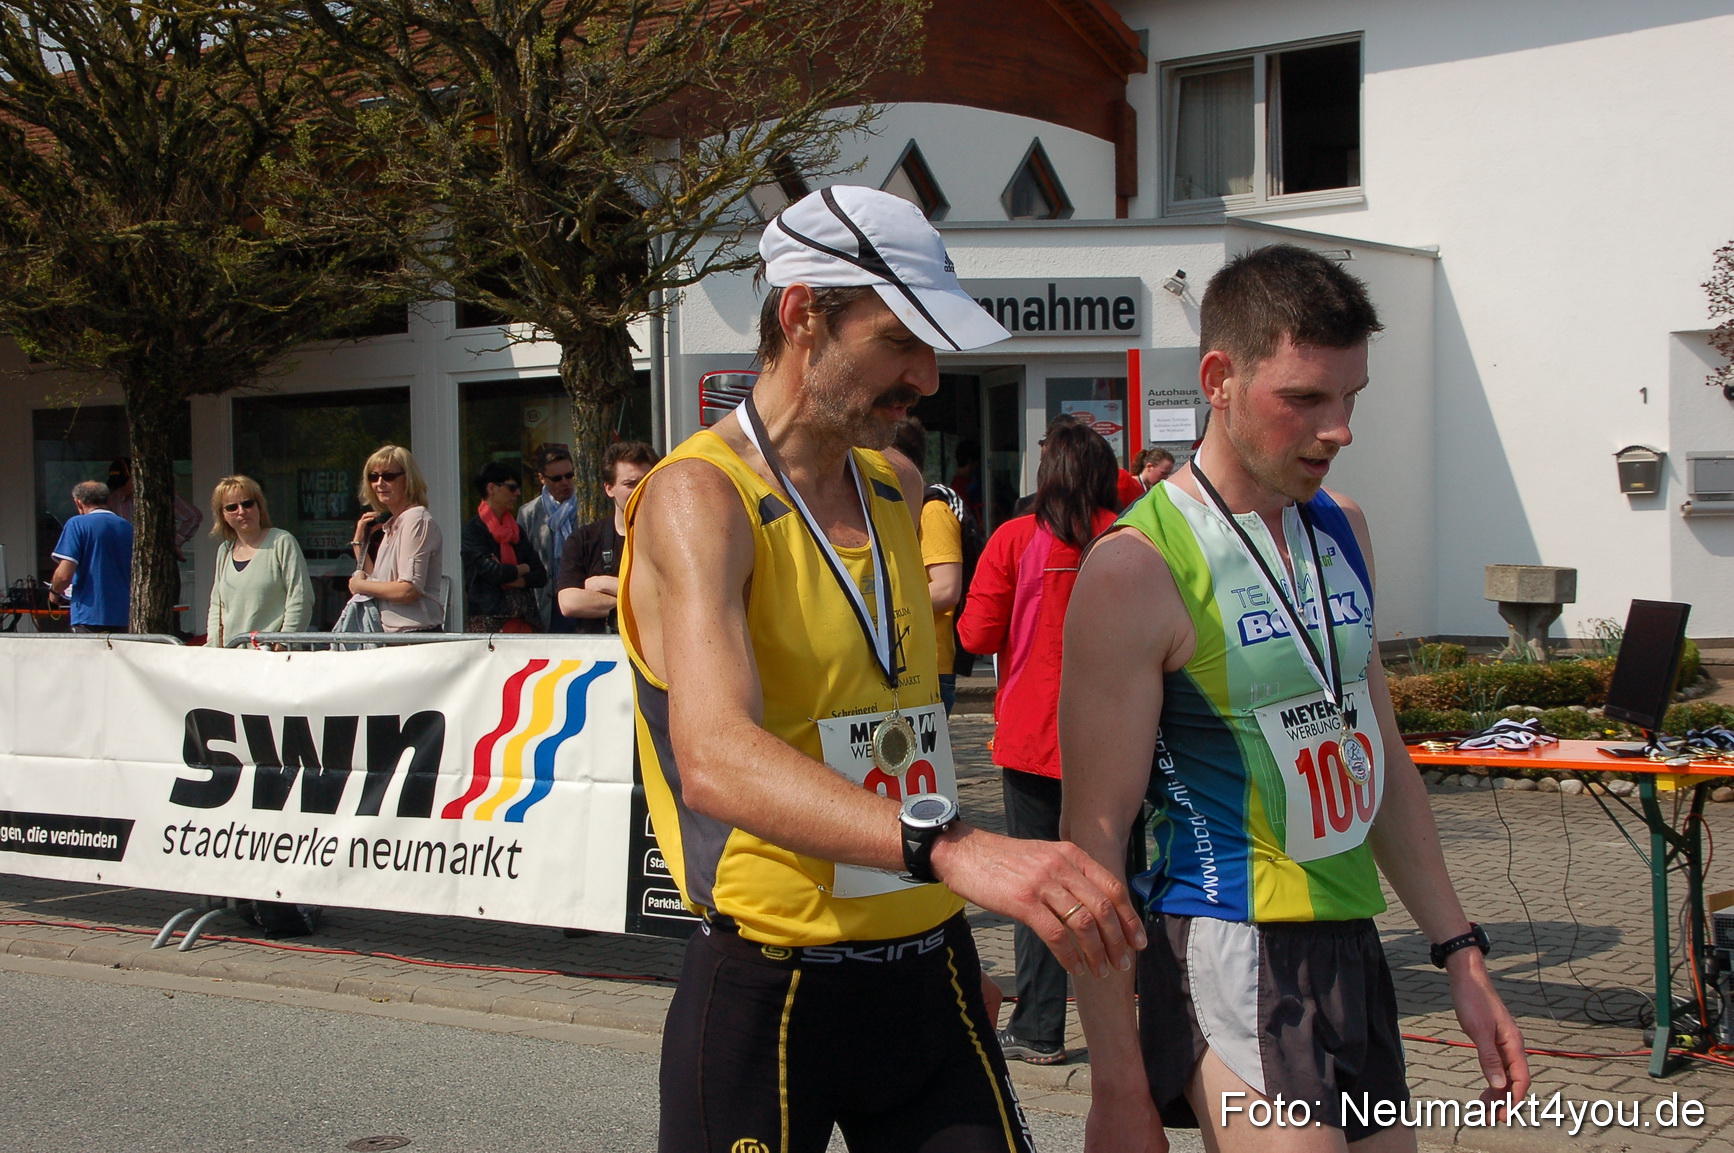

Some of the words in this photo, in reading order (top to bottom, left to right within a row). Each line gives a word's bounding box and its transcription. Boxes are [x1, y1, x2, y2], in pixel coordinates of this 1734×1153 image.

[1148, 389, 1199, 397] Autohaus
[1148, 398, 1189, 407] Gerhart
[1194, 397, 1201, 405] &
[302, 471, 349, 492] MEHR
[302, 493, 349, 518] WERT
[880, 675, 921, 692] NMARKT
[1280, 699, 1341, 729] MEYER
[1286, 717, 1341, 742] WERBUNG
[169, 708, 446, 819] swn
[1294, 732, 1375, 839] 100
[27, 826, 48, 843] die
[50, 830, 118, 849] verbinden
[162, 820, 339, 868] stadtwerke
[349, 835, 523, 880] neumarkt
